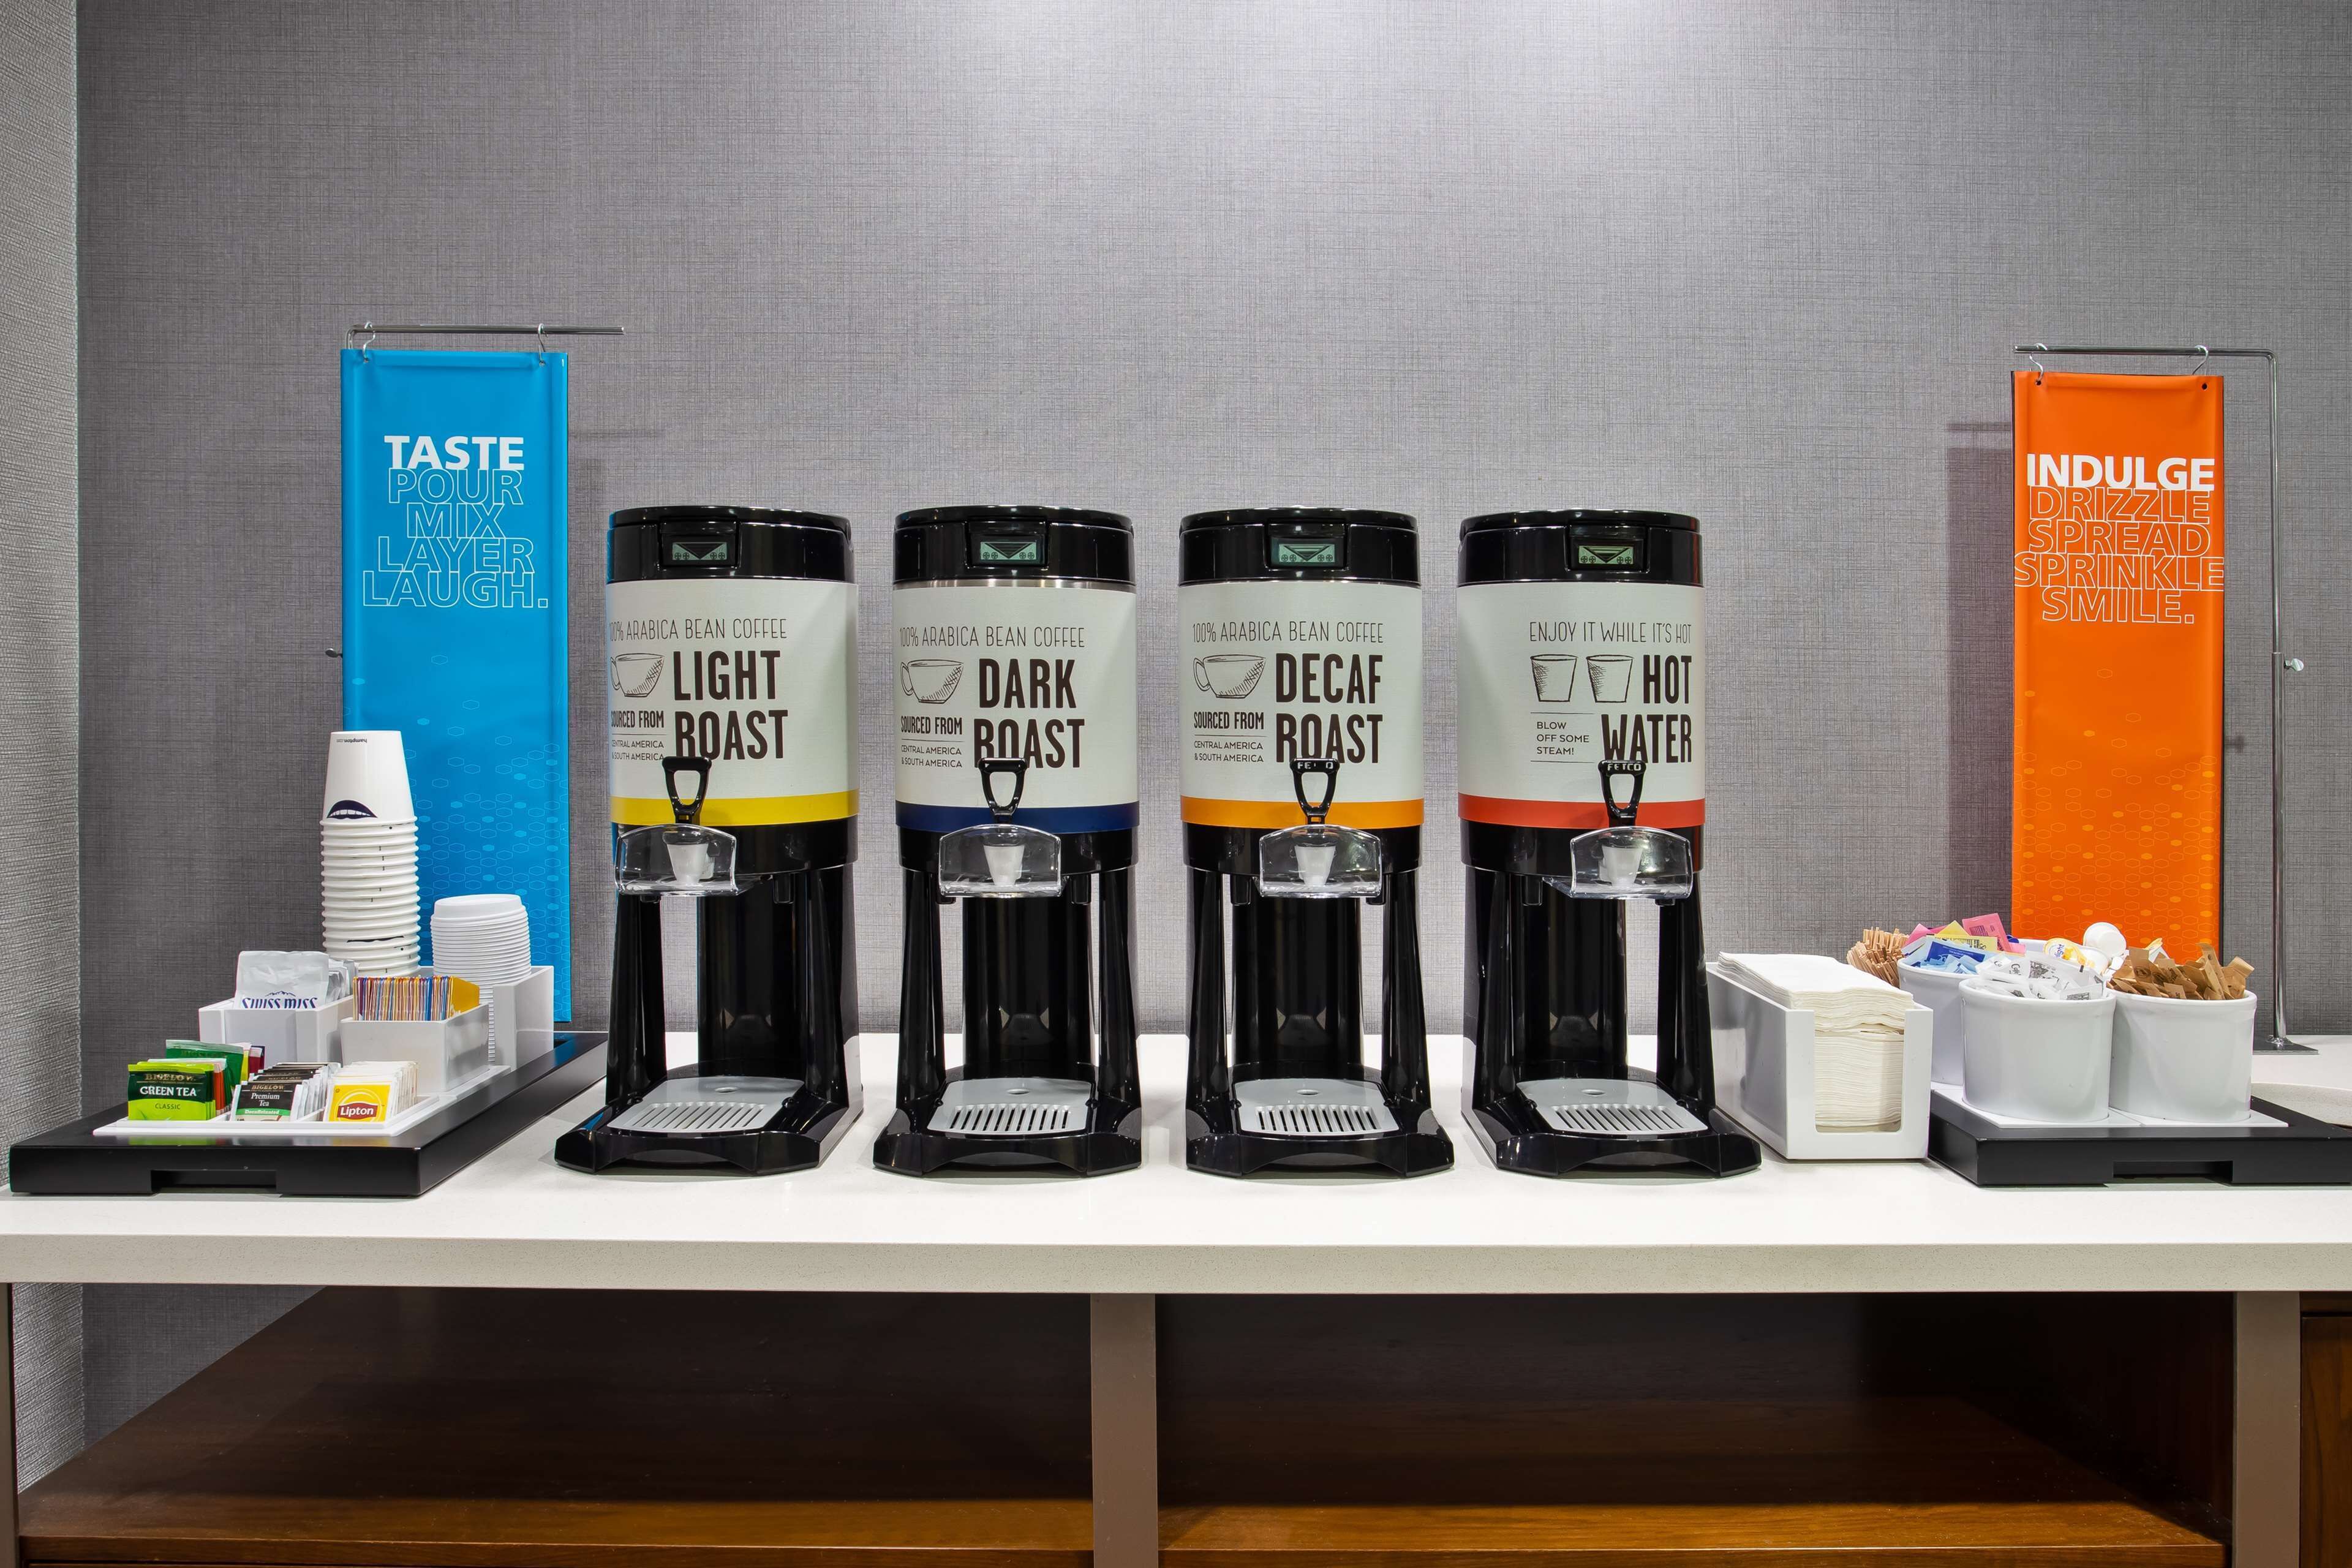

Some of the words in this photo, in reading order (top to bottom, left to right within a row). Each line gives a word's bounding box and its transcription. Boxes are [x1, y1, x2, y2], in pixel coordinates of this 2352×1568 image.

[384, 435, 524, 470] TASTE
[388, 469, 523, 505] POUR
[2027, 454, 2215, 491] INDULGE
[407, 503, 505, 538] MIX
[2030, 486, 2210, 525] DRIZZLE
[378, 536, 534, 573] LAYER
[2028, 519, 2211, 557] SPREAD
[363, 570, 548, 608] LAUGH.
[2014, 551, 2225, 592] SPRINKLE
[2042, 586, 2194, 624] SMILE.
[626, 619, 679, 640] ARABICA
[685, 619, 725, 639] BEAN
[734, 619, 787, 638] COFFEE
[900, 627, 919, 647] 100%
[922, 626, 979, 647] ARABICA
[986, 627, 1026, 646] BEAN
[1034, 627, 1084, 647] COFFEE
[1193, 622, 1216, 643] 100%
[1221, 621, 1282, 642] ARABICA
[1289, 621, 1329, 642] BEAN
[1336, 622, 1384, 643] COFFEE
[1530, 622, 1577, 642] ENJOY
[1583, 622, 1596, 642] IT
[1600, 622, 1646, 643] WHILE
[1653, 622, 1672, 643] IT'S
[1676, 624, 1692, 644] HOT
[674, 650, 780, 701] LIGHT
[979, 658, 1077, 709] DARK
[1276, 653, 1382, 704] DECAF
[1643, 655, 1692, 704] HOT
[639, 710, 664, 728] FROM
[675, 709, 788, 760] ROAST
[901, 715, 931, 734] SOURCED
[935, 717, 962, 735] FROM
[1194, 712, 1229, 729] SOURCED
[1234, 712, 1264, 729] FROM
[901, 745, 924, 753] CENTRAL
[925, 747, 962, 755] AMERICA
[974, 718, 1085, 768] ROAST
[1194, 741, 1223, 749] CENTRAL
[1223, 742, 1264, 750] AMERICA
[1276, 713, 1383, 763] ROAST
[1537, 747, 1574, 755] STEAM!
[1601, 714, 1692, 763] WATER
[905, 757, 924, 766] SOUTH
[925, 759, 962, 767] AMERICA
[1199, 753, 1222, 761] SOUTH
[1223, 754, 1264, 763] AMERICA
[140, 1086, 174, 1095] GREEN
[176, 1087, 197, 1096] TEA
[341, 1107, 374, 1117] Lipton
